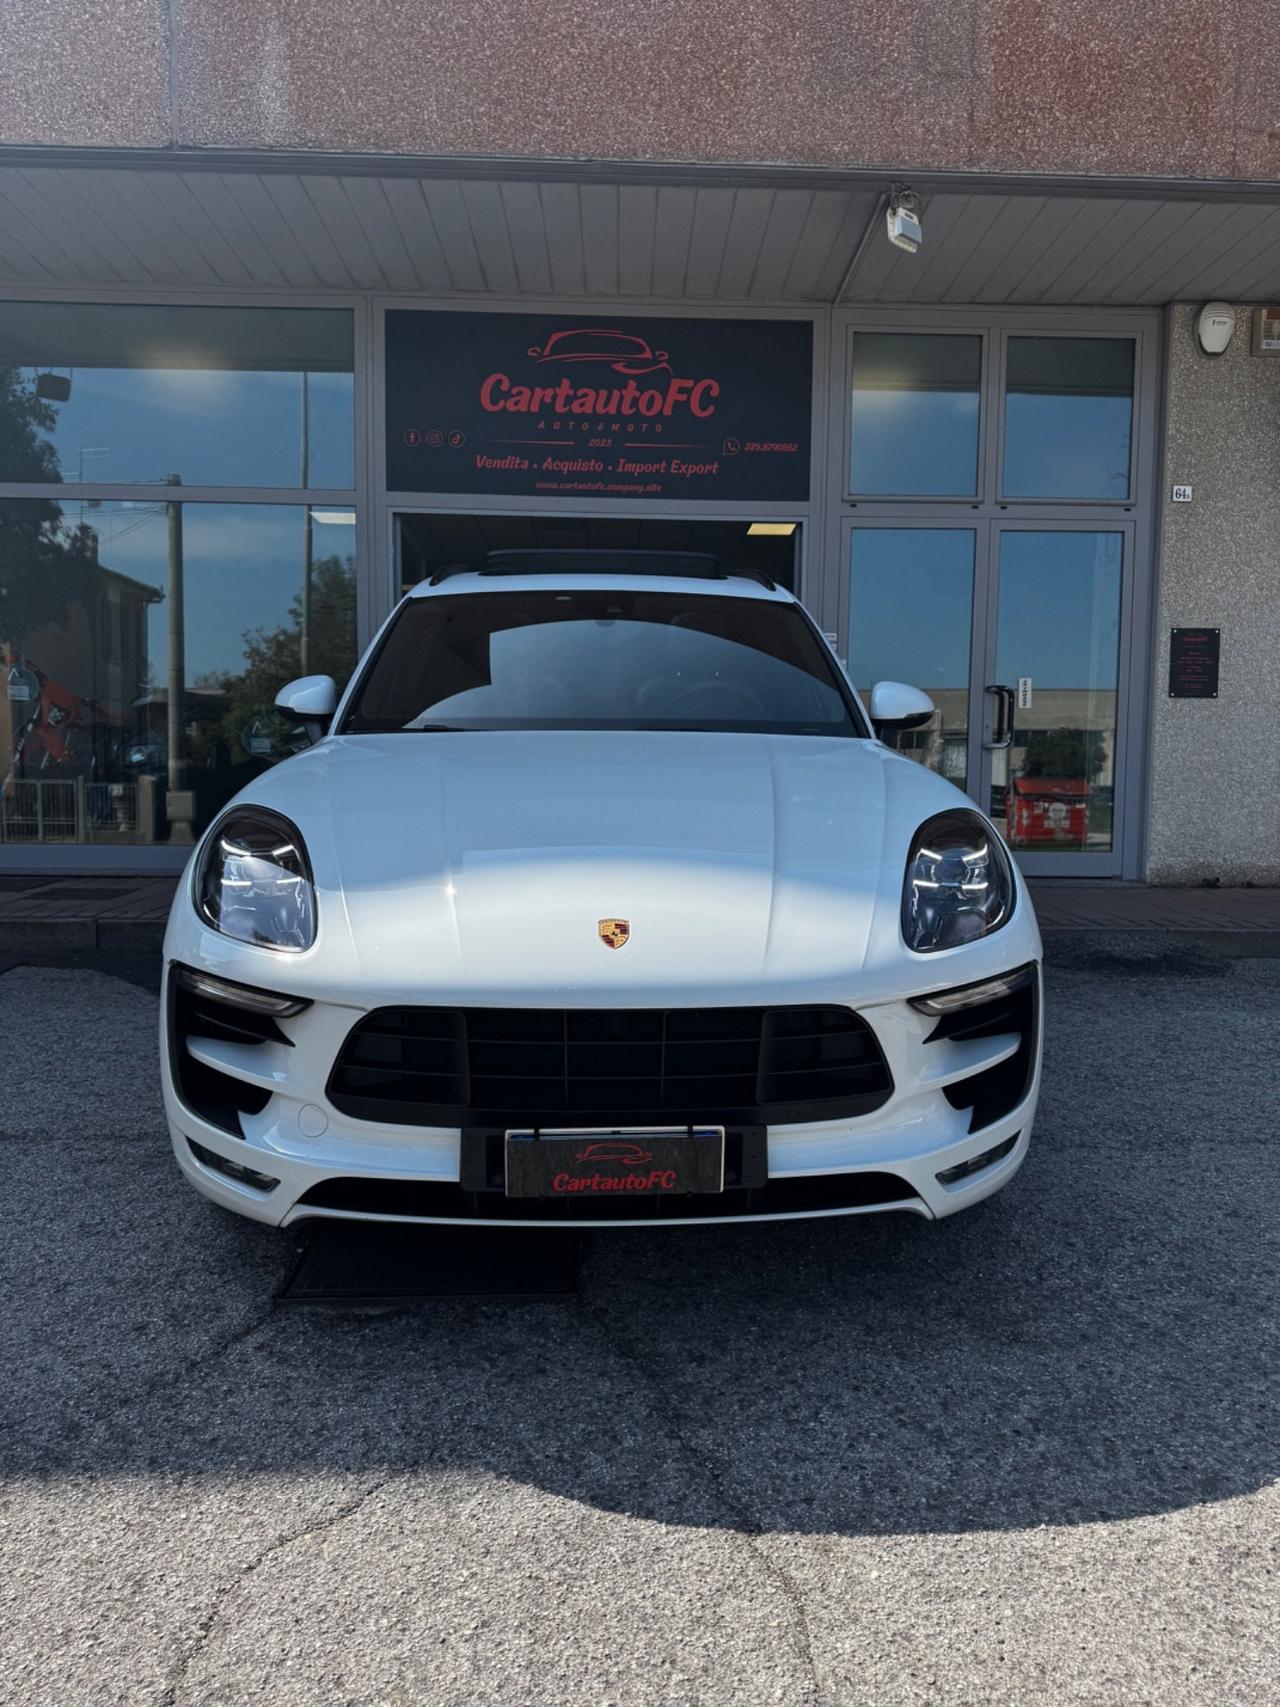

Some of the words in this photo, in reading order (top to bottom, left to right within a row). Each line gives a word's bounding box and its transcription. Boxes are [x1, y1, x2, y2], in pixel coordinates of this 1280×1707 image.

[480, 373, 720, 417] CartautoFC
[475, 454, 529, 470] Vendita
[542, 456, 604, 475] Acquisto
[616, 458, 667, 477] Import
[670, 460, 719, 478] Export
[552, 1171, 676, 1192] CartautoFC
